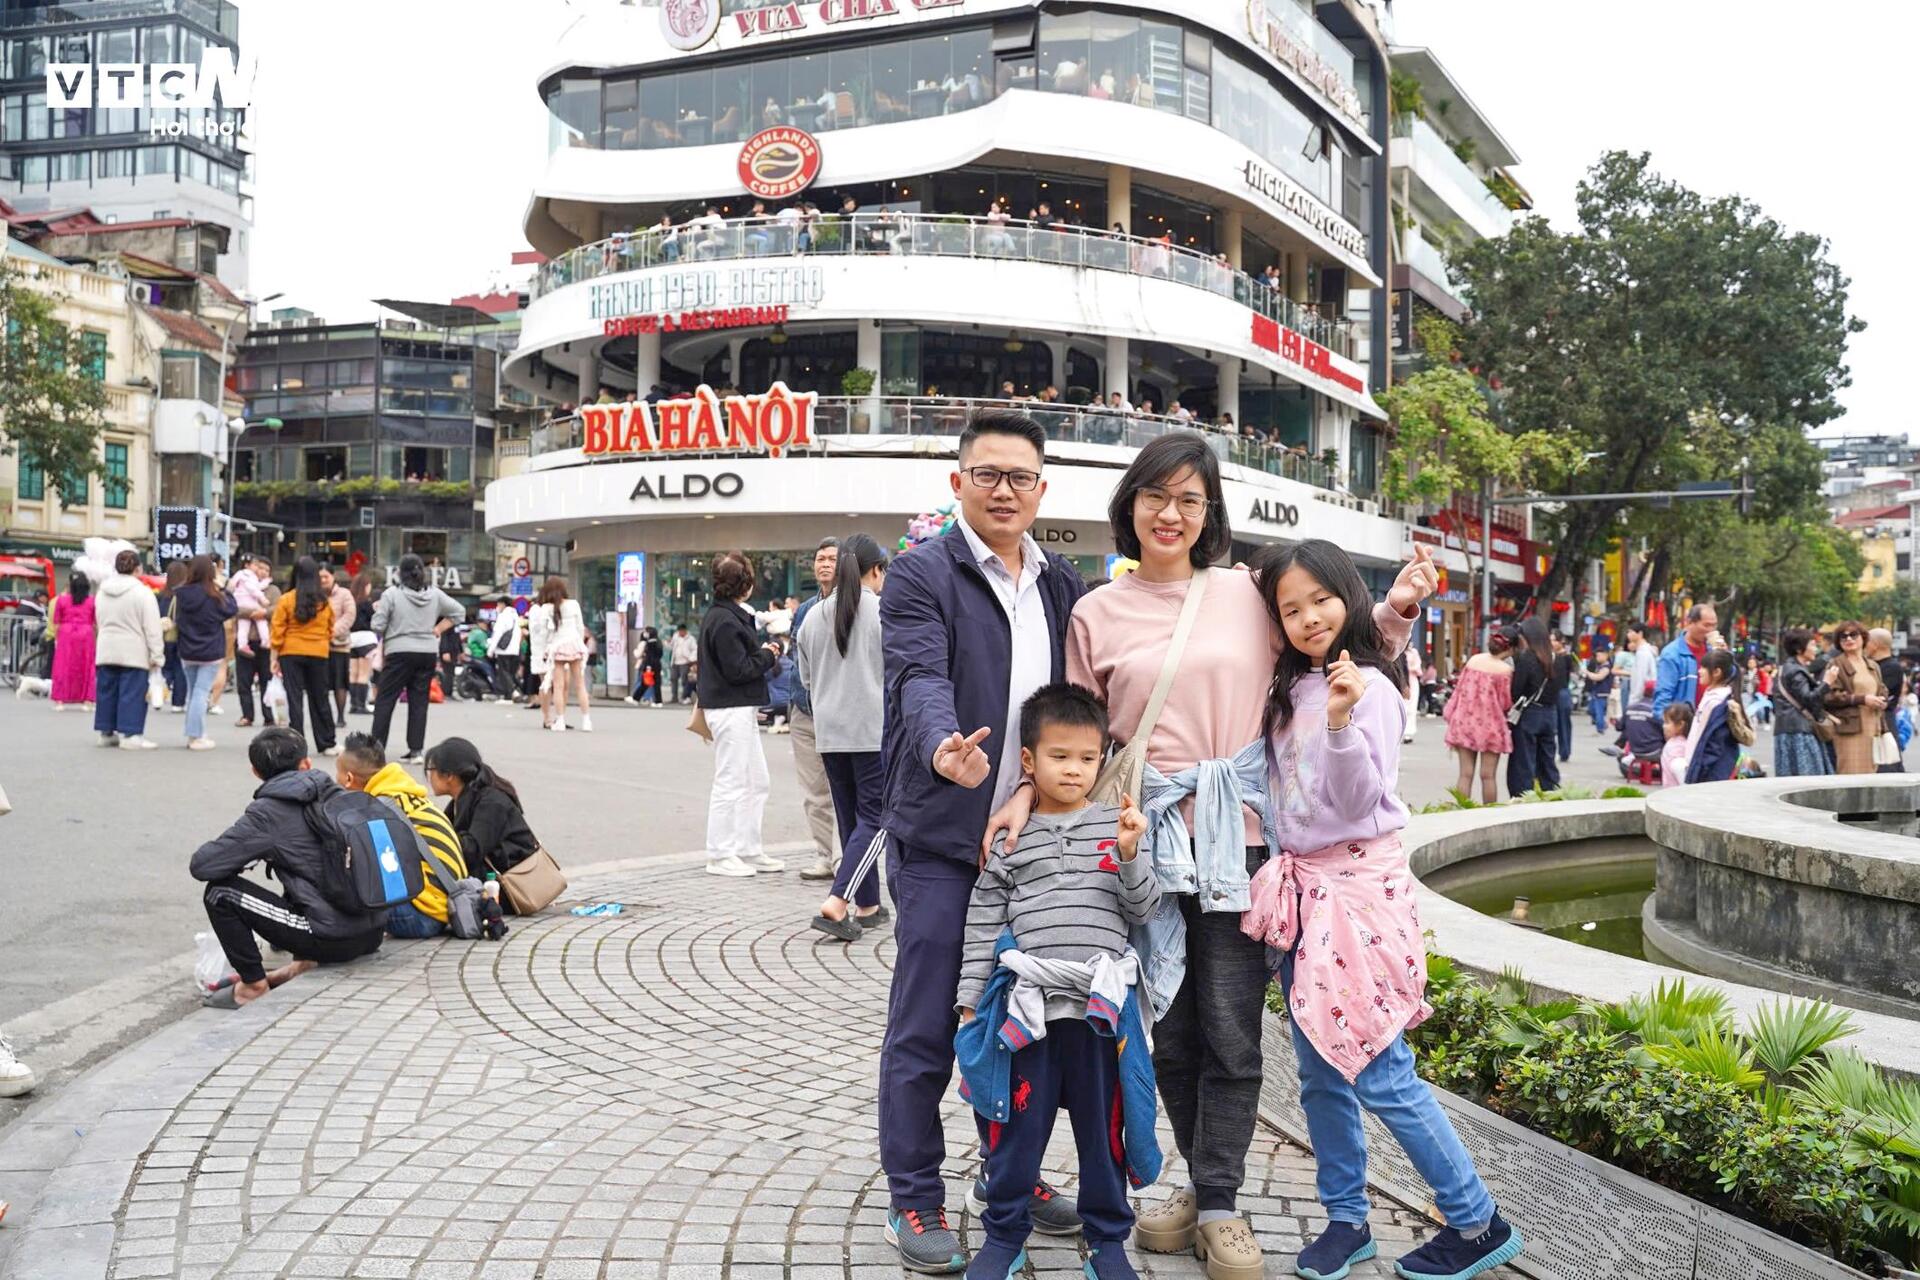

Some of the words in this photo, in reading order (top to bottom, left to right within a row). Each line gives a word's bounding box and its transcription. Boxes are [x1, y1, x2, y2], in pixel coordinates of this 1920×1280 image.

[733, 3, 806, 37] VUA
[741, 131, 815, 164] HIGHLANDS
[750, 174, 807, 195] COFFEE
[1245, 160, 1325, 231] HIGHLANDS
[1324, 216, 1367, 258] COFFEE
[587, 277, 652, 319] HANOI
[660, 270, 716, 310] 1930
[728, 266, 823, 305] BISTRO
[604, 315, 659, 336] COFFEE
[663, 315, 675, 332] &
[680, 304, 789, 331] RESTAURANT
[582, 405, 654, 456] BIA
[658, 386, 723, 453] HÀ
[726, 385, 815, 459] NỘI
[629, 472, 744, 501] ALDO
[1248, 497, 1299, 527] ALDO
[165, 523, 188, 539] FS
[1032, 528, 1077, 543] LDO
[160, 543, 194, 560] SPA
[383, 565, 463, 589] KFA
